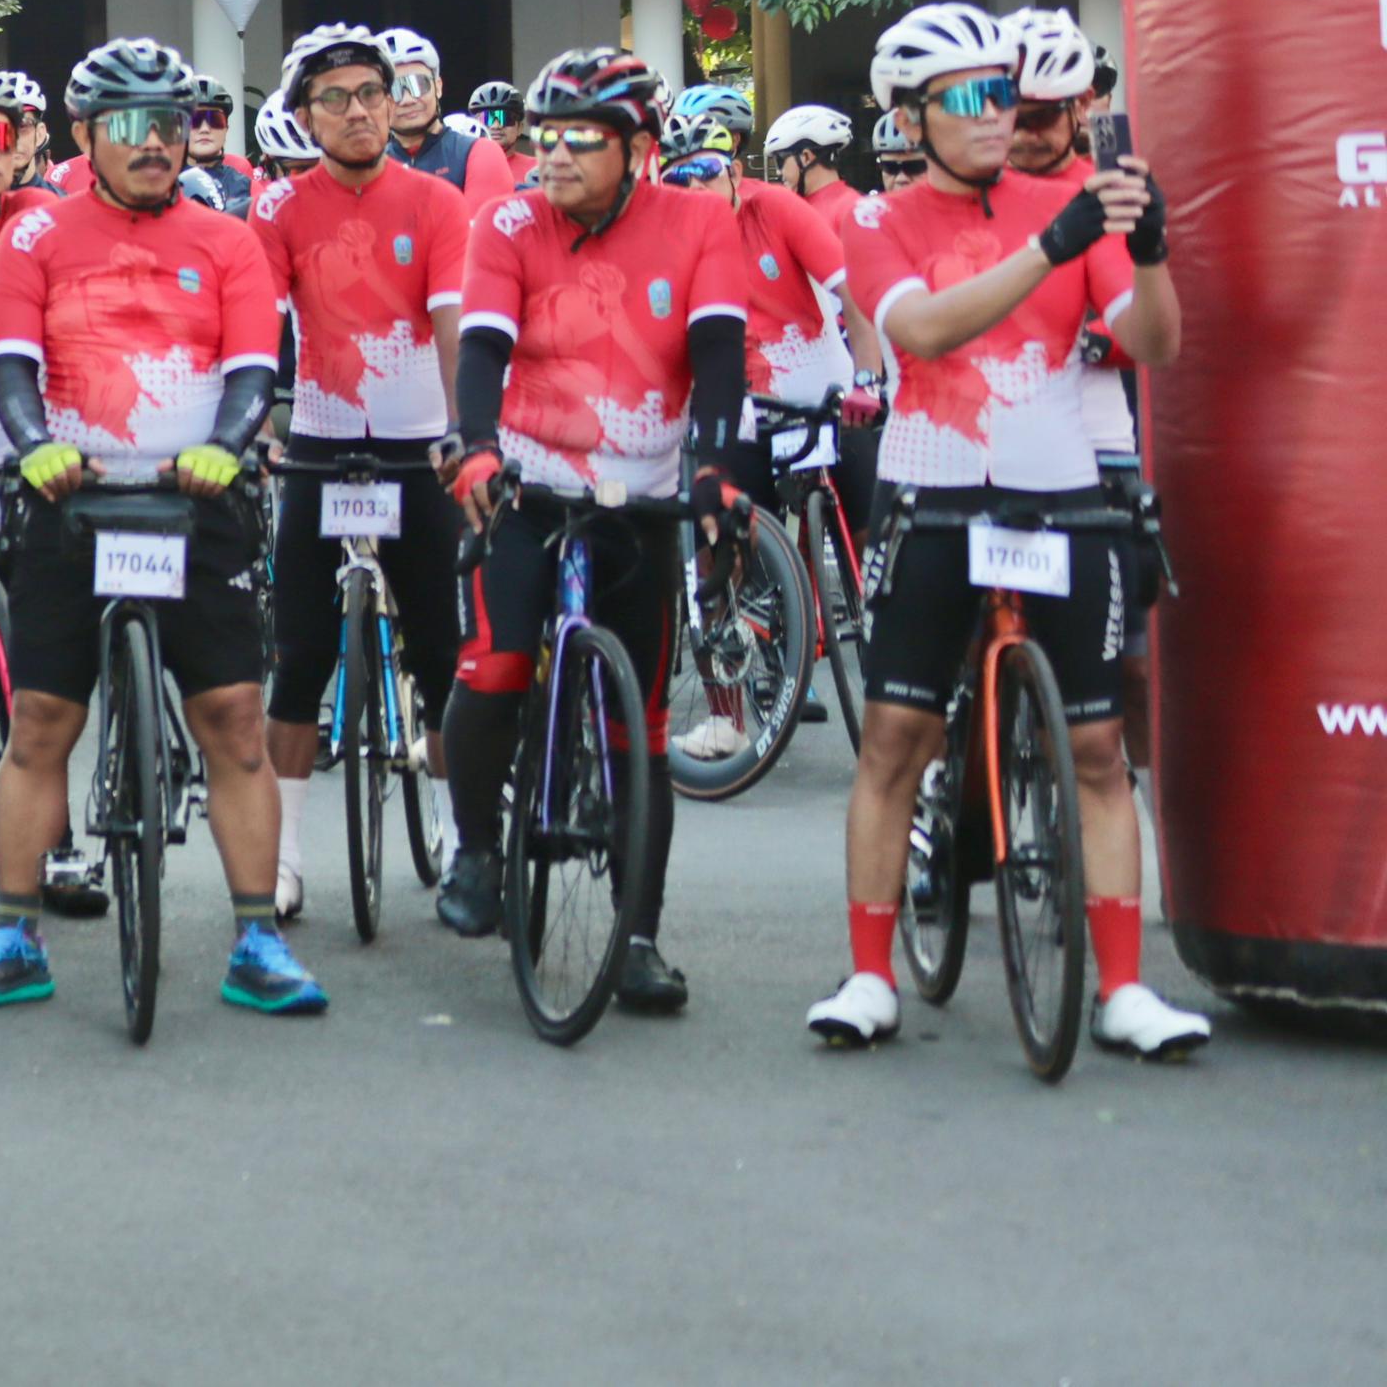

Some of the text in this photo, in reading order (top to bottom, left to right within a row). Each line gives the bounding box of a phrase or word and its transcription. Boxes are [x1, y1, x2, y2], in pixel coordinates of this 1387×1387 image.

[1335, 132, 1387, 183] G
[255, 176, 294, 222] CNN
[1337, 186, 1387, 209] AL
[10, 207, 54, 253] CNN
[332, 499, 389, 517] 17033
[106, 553, 173, 574] 17044
[987, 548, 1050, 571] 17001
[755, 678, 796, 759] DT SWISS
